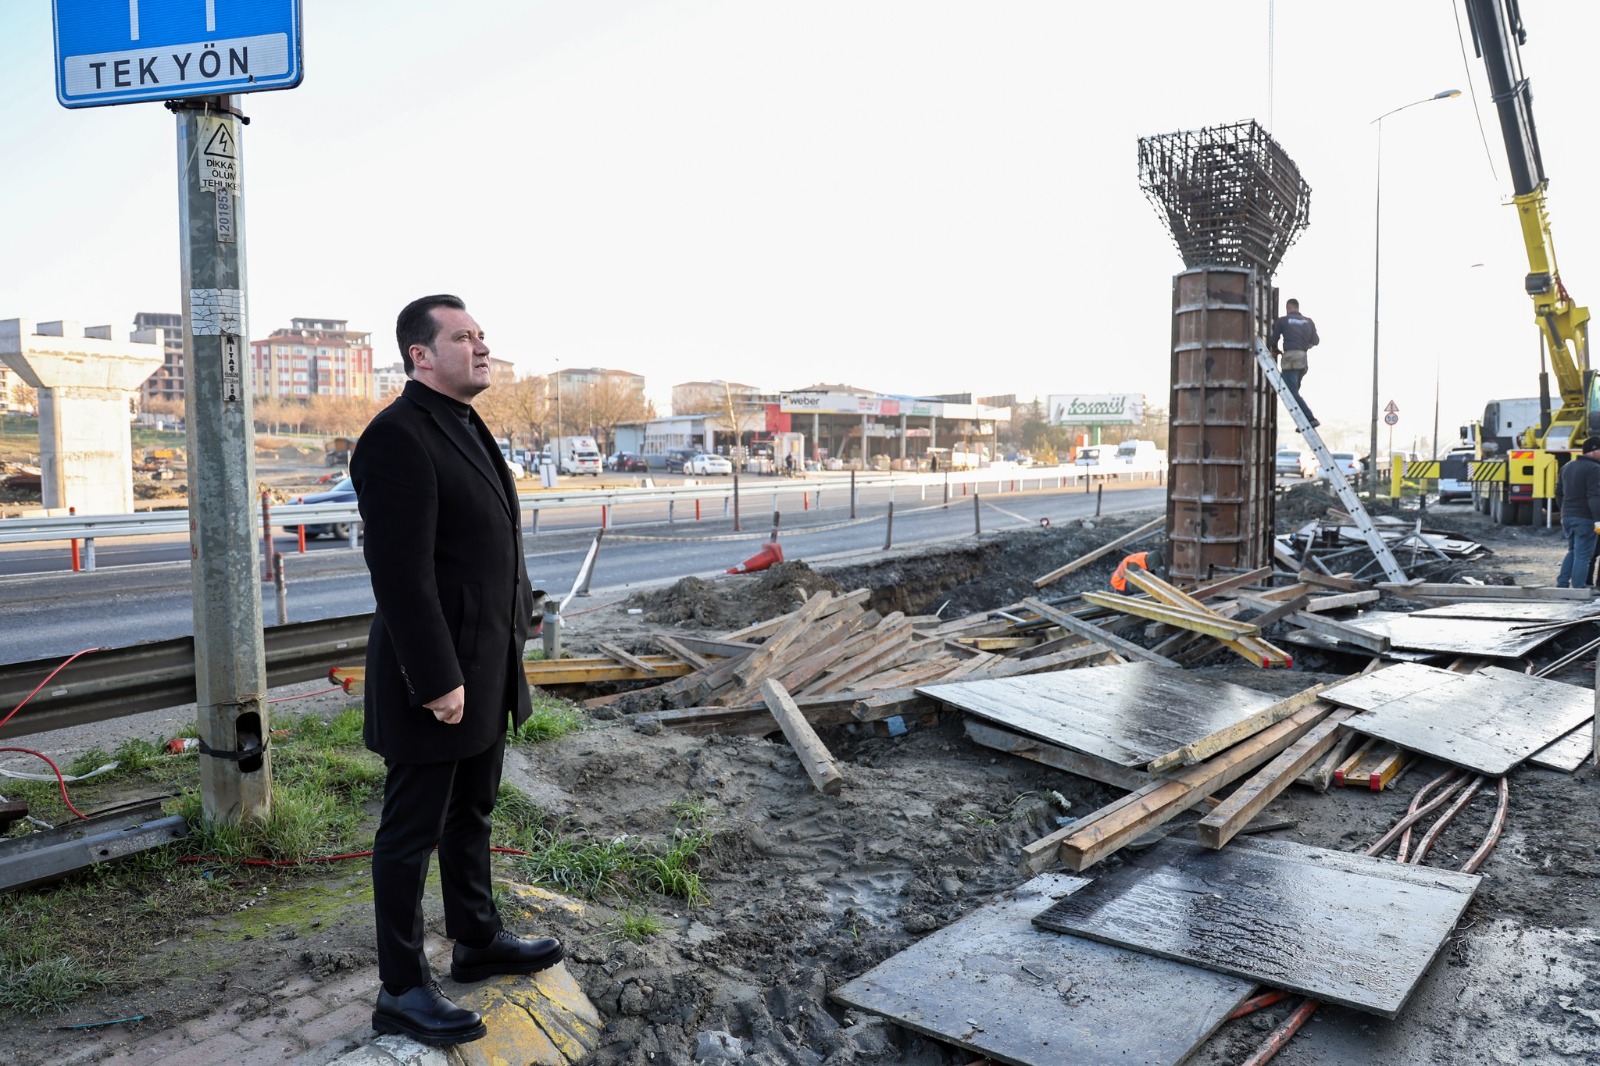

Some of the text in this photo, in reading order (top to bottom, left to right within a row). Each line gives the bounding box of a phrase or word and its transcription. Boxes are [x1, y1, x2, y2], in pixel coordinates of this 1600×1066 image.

[89, 43, 248, 89] TEK YÖN
[218, 188, 230, 240] 1201853
[790, 396, 820, 406] weber
[1068, 396, 1126, 415] formül
